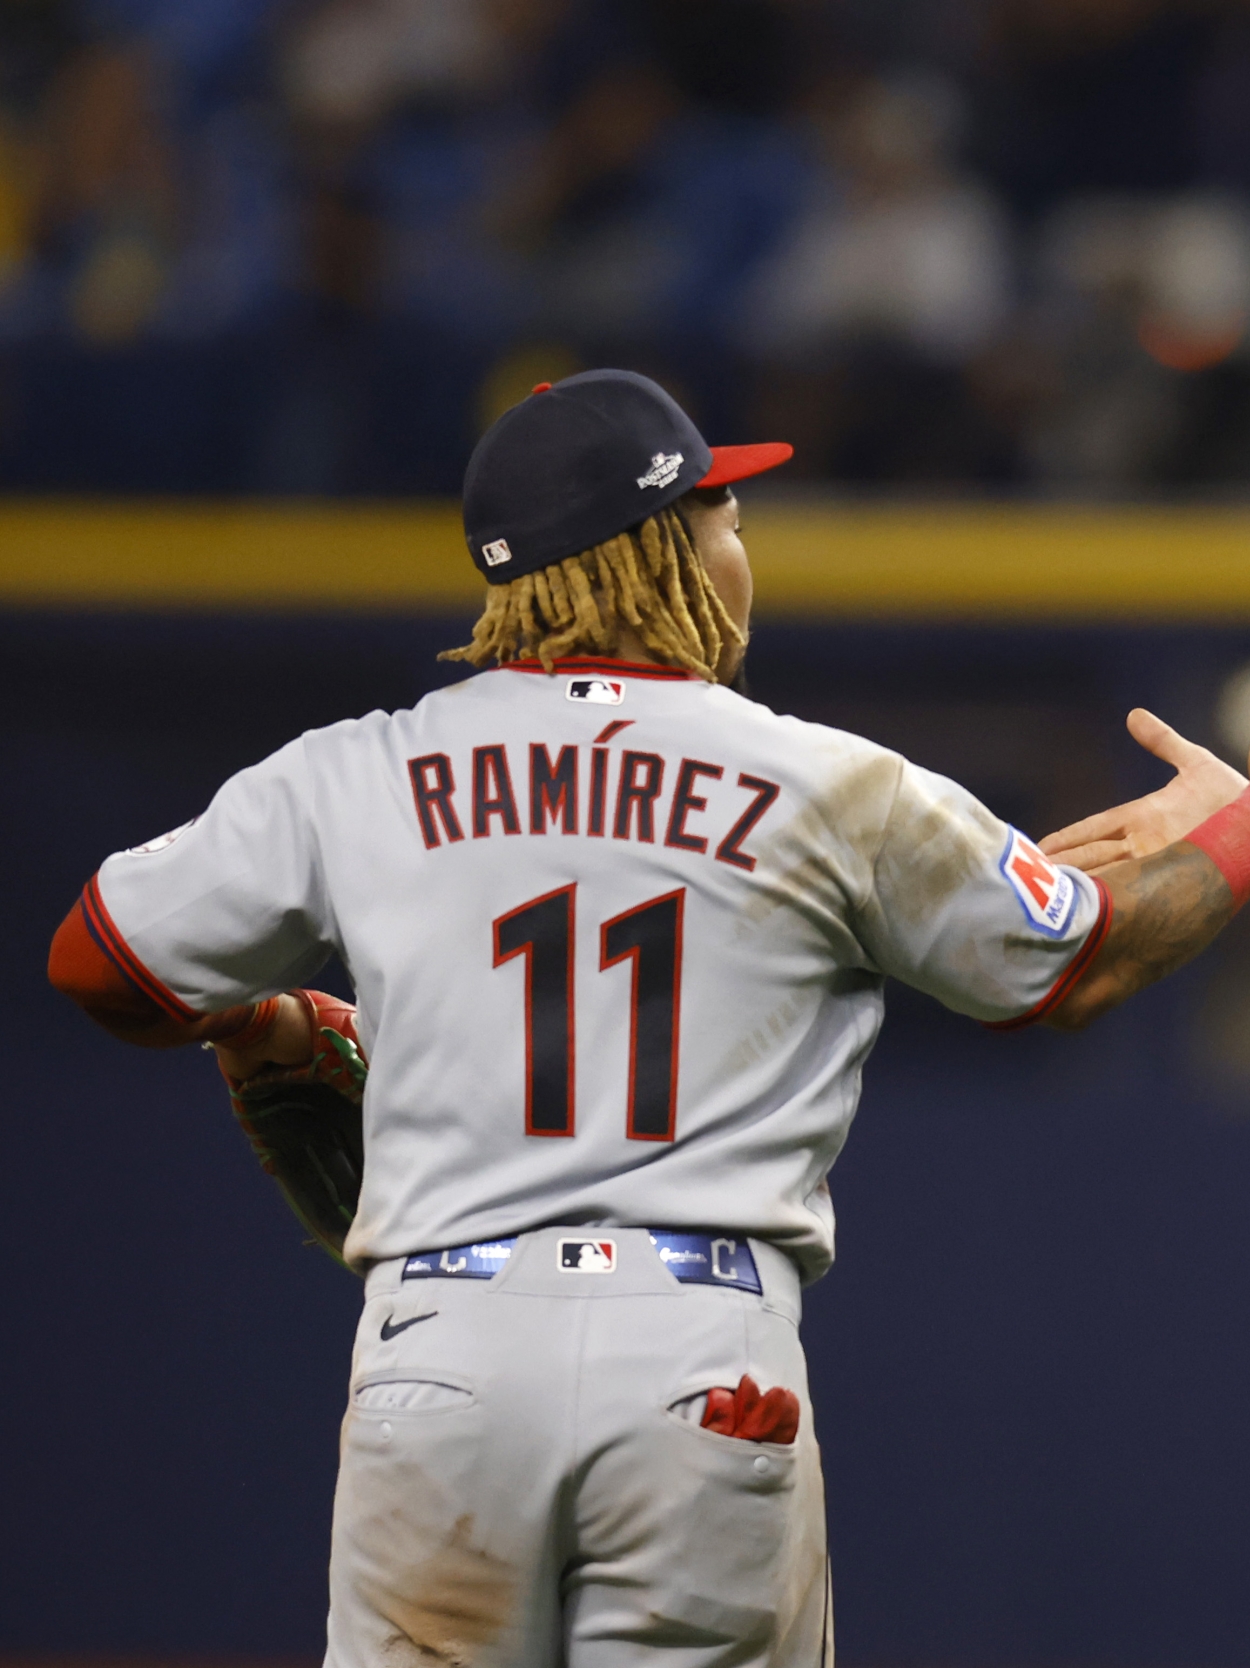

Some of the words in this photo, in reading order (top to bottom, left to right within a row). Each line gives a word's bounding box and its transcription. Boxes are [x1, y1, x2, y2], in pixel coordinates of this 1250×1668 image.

[407, 720, 780, 872] RAMÍREZ
[492, 882, 686, 1142] 11
[710, 1238, 738, 1280] C
